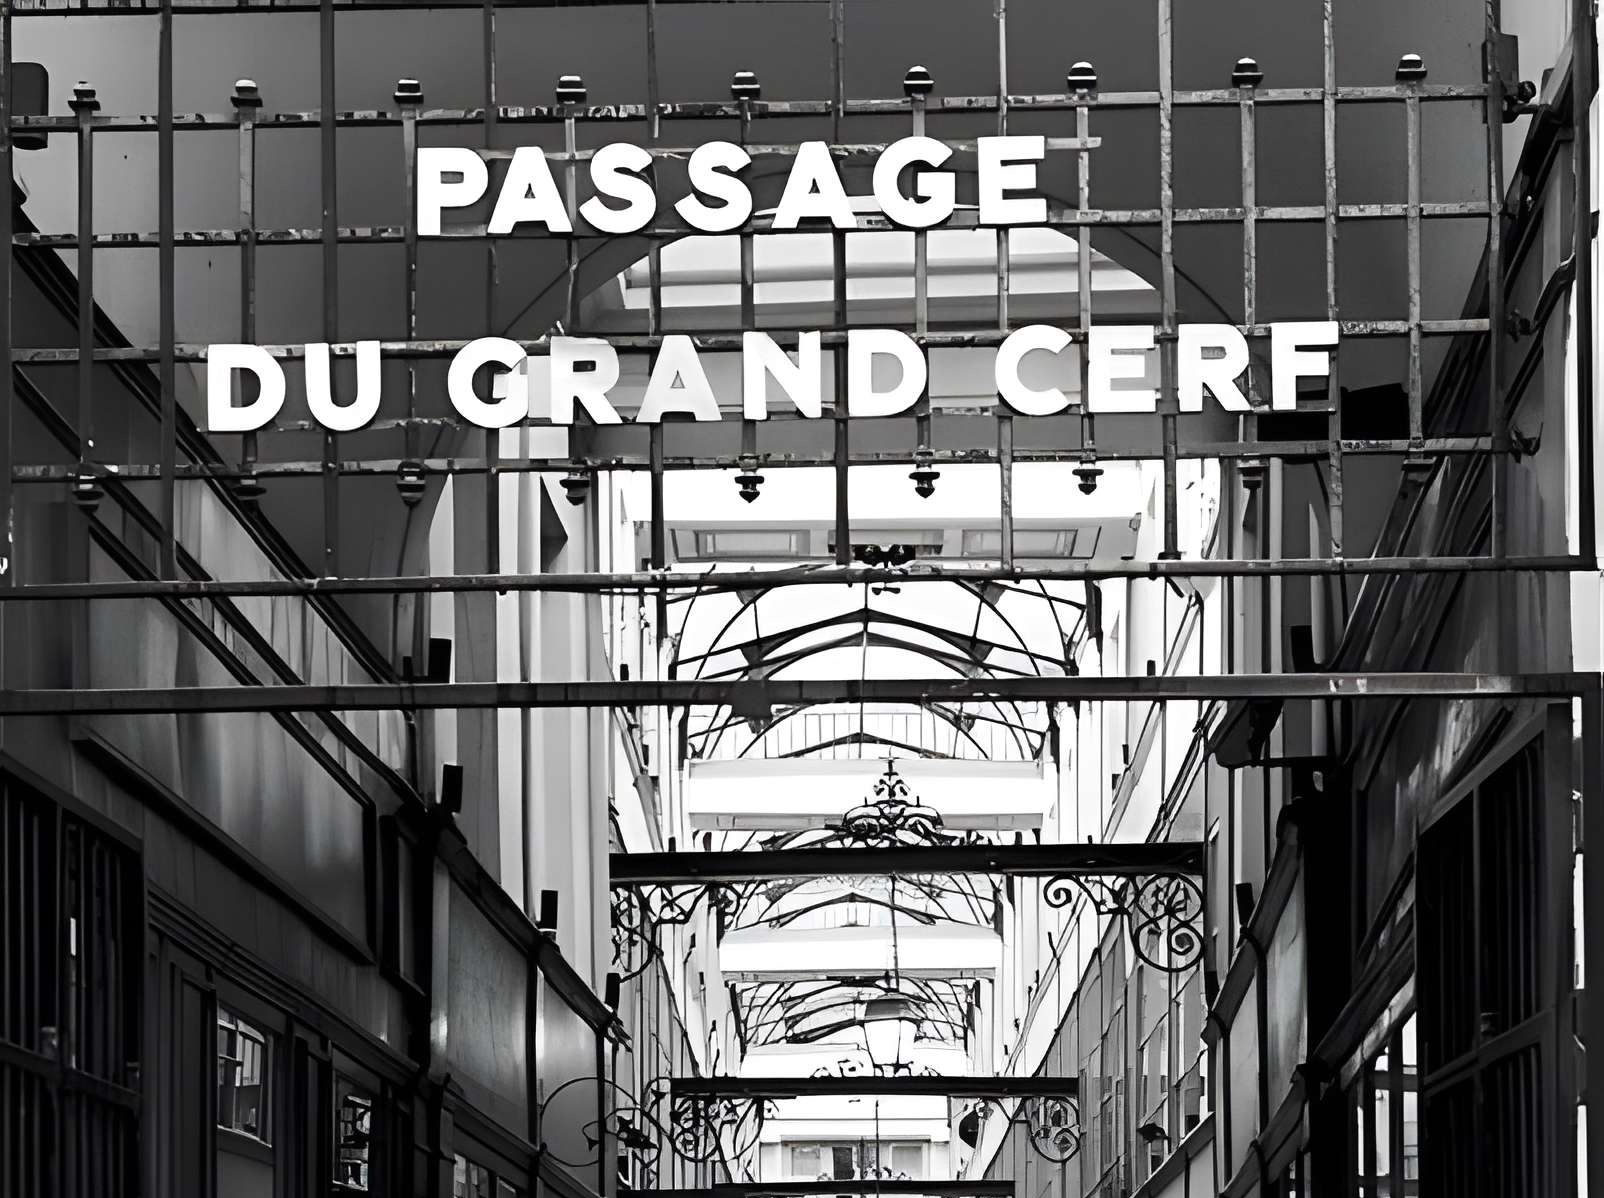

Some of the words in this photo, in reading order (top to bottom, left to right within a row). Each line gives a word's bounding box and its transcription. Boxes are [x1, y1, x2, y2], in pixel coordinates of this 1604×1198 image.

[416, 135, 1048, 236] PASSAGE
[206, 340, 382, 432] DU
[447, 329, 928, 429] GRAND
[994, 320, 1340, 416] CERF
